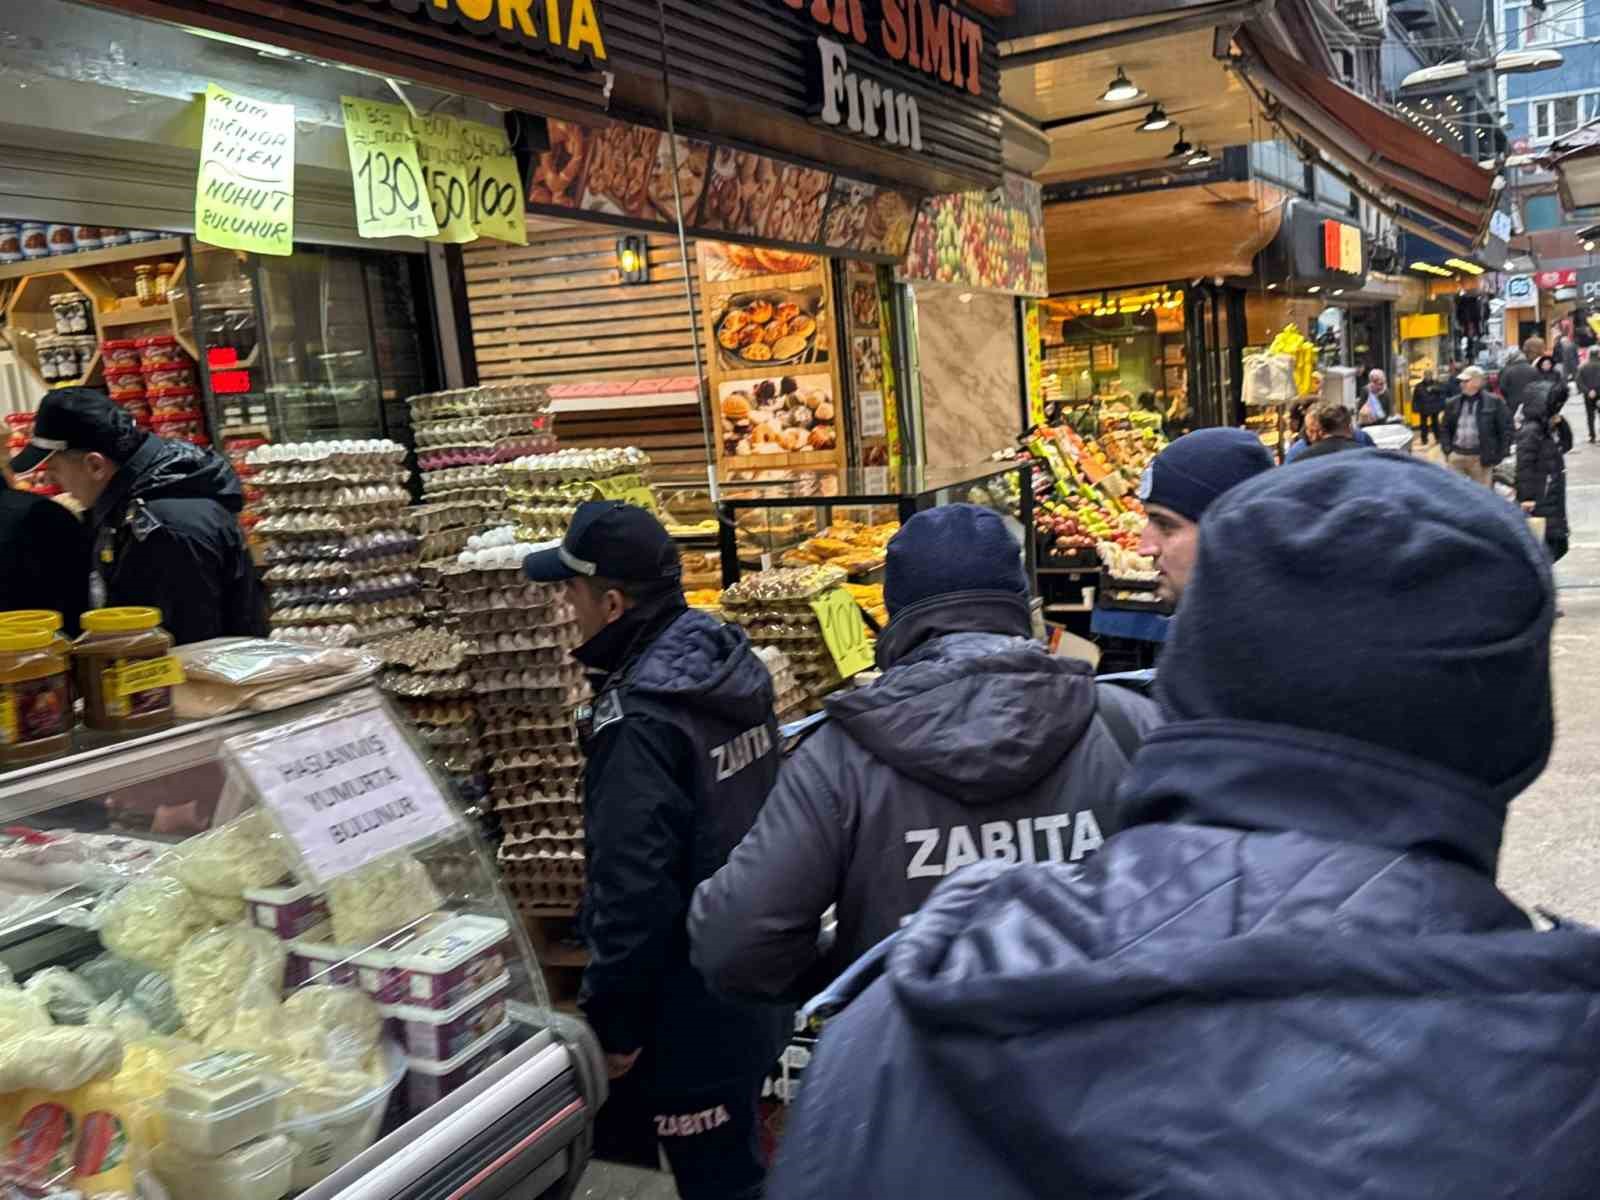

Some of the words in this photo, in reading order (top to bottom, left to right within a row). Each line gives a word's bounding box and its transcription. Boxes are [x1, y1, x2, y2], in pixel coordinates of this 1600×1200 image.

[205, 178, 295, 211] NOHUT
[358, 151, 419, 223] 130
[469, 165, 517, 225] 100
[201, 208, 288, 243] BULUNUR
[709, 723, 771, 782] ZABITA
[303, 766, 402, 812] YUMURTA
[328, 796, 420, 844] BULUNUR
[905, 809, 1104, 879] ZABITA
[653, 1104, 731, 1136] ZABITA
